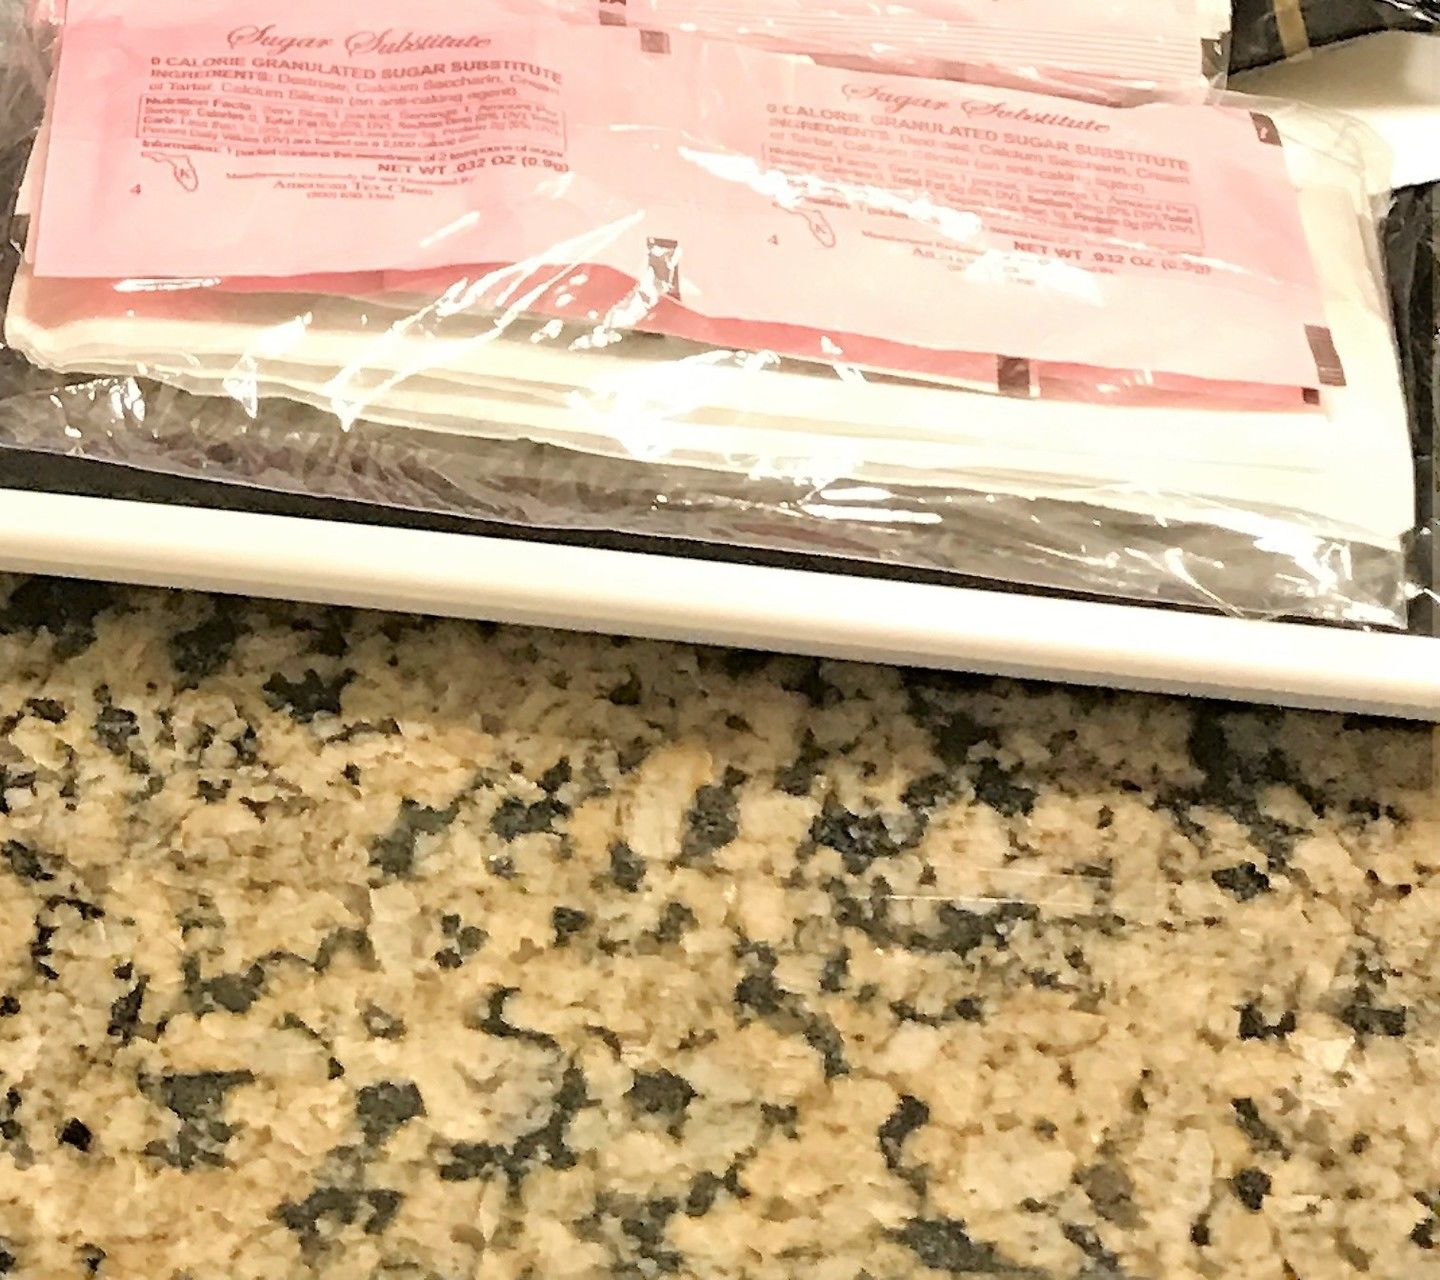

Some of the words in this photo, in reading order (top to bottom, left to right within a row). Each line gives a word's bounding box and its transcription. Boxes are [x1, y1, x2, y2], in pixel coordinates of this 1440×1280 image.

[226, 23, 334, 57] Sugar
[165, 57, 246, 68] CALORIE
[251, 56, 377, 80] GRANULATED
[381, 62, 446, 80] SUGAR
[450, 59, 564, 87] SUBSTITUTE
[1003, 132, 1060, 153] SUGAR
[1074, 142, 1191, 172] SUBSTITUTE
[377, 162, 412, 174] NET
[418, 163, 448, 176] WT
[1054, 247, 1084, 261] WT
